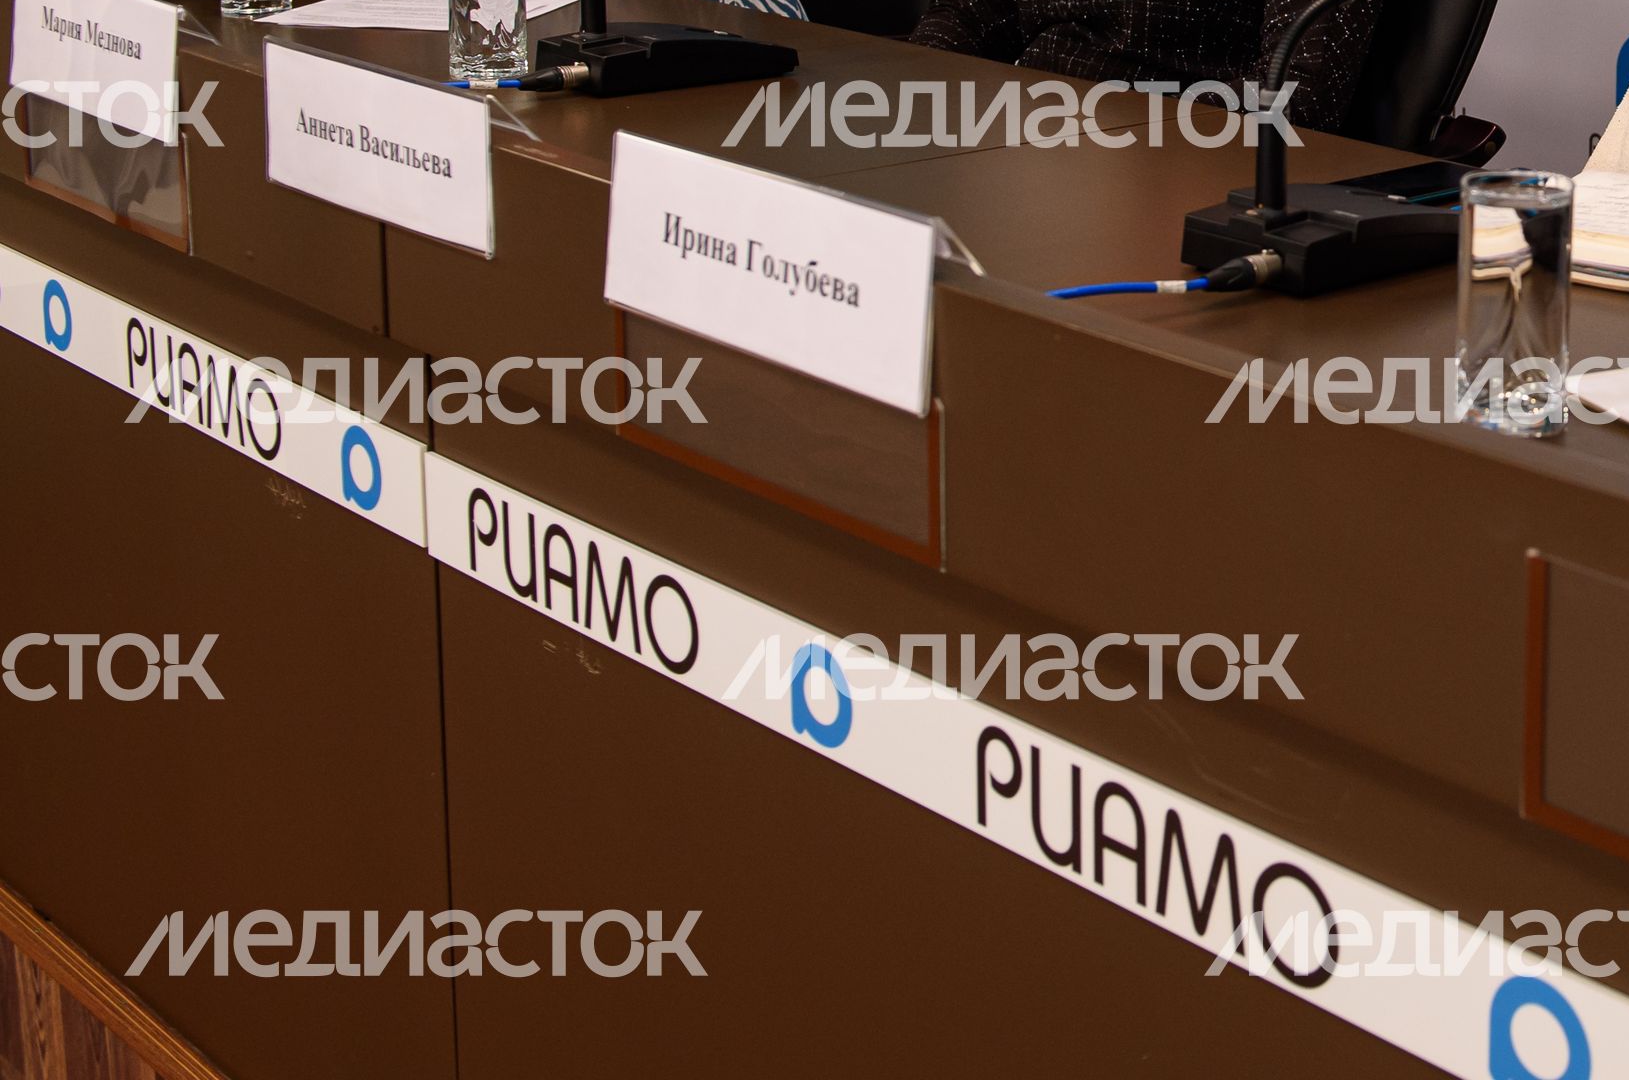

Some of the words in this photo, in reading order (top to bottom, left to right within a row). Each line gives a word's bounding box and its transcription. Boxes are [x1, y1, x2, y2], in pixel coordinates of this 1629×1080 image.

[41, 5, 82, 42] Мария
[296, 107, 354, 149] Аннета
[358, 123, 453, 179] Васильева
[662, 211, 738, 266] Ирина
[745, 238, 860, 308] Голубева
